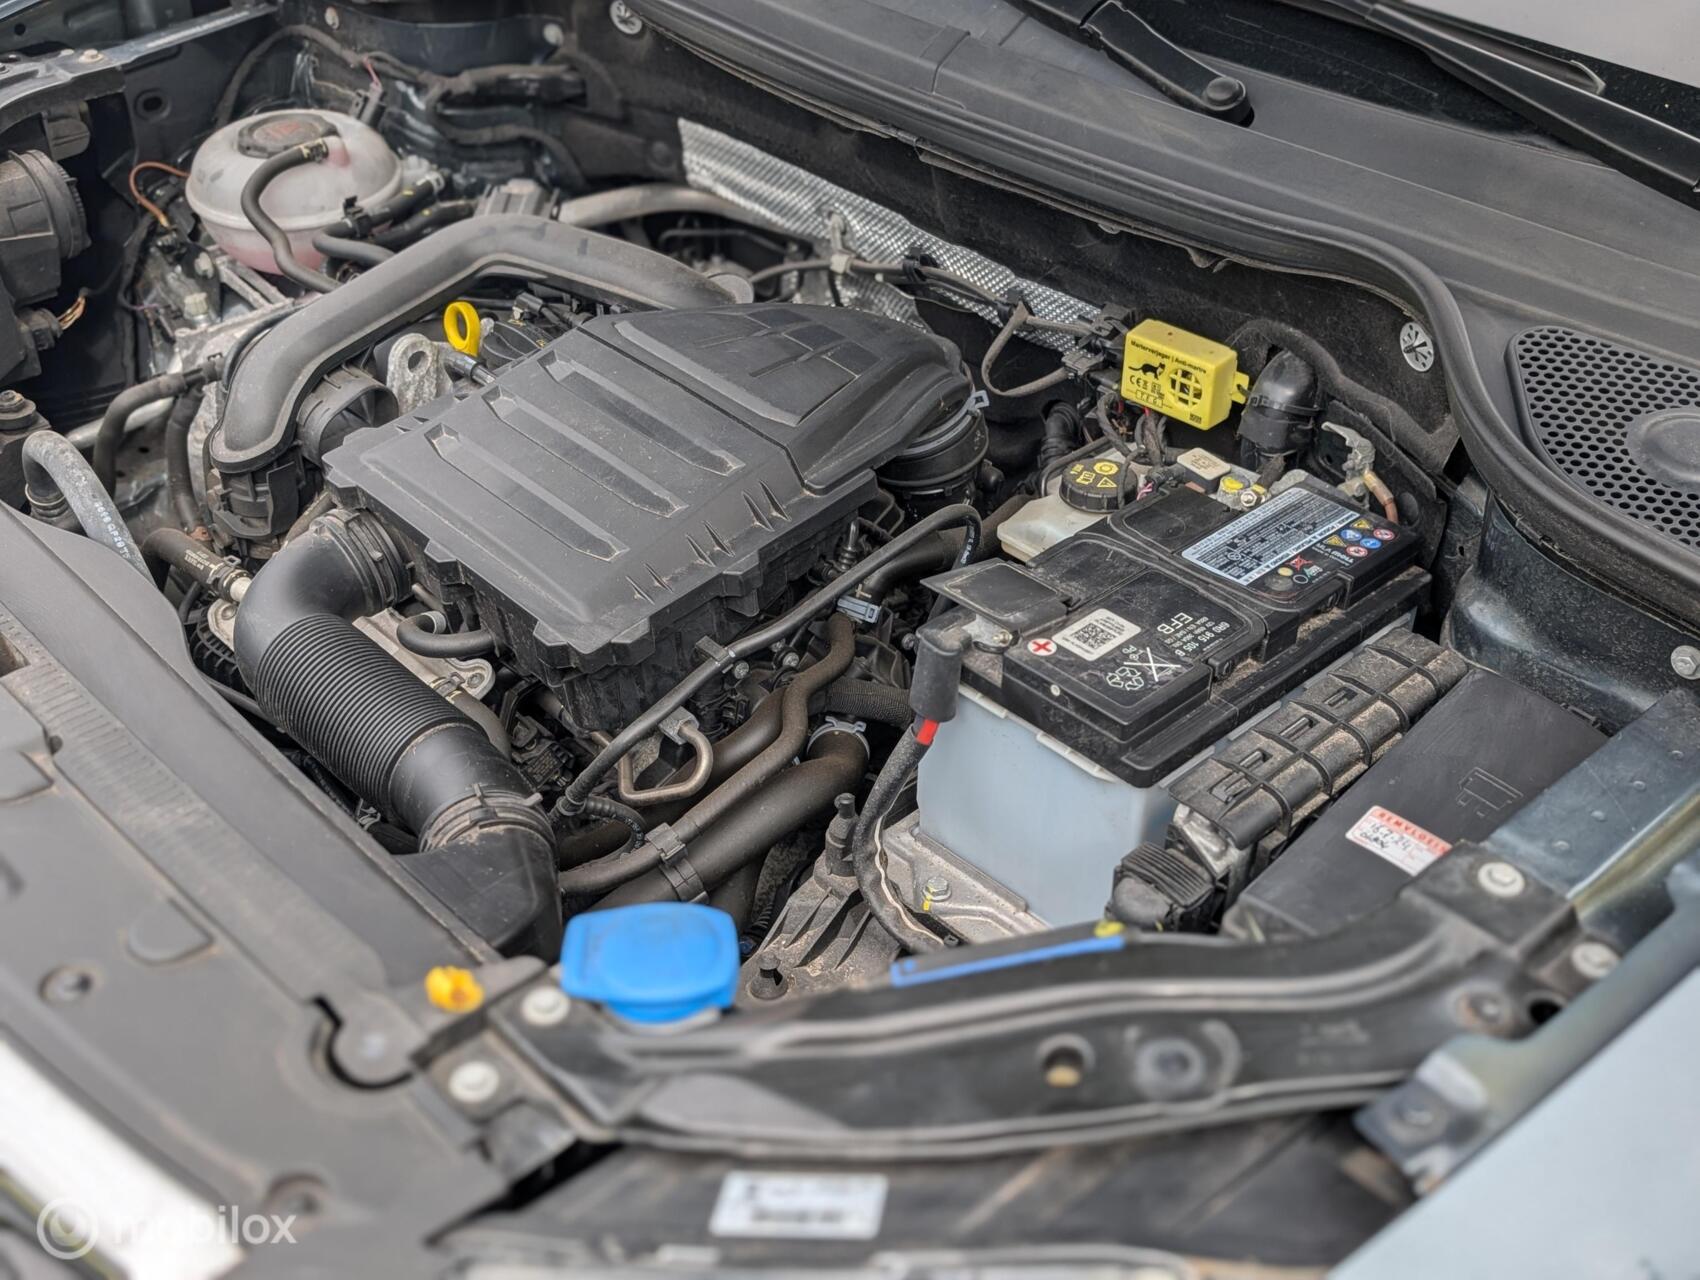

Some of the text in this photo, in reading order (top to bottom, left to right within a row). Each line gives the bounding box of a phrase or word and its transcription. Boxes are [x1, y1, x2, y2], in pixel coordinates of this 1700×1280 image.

[1157, 612, 1193, 635] EFB
[1197, 630, 1215, 642] 915
[1182, 641, 1199, 652] 105
